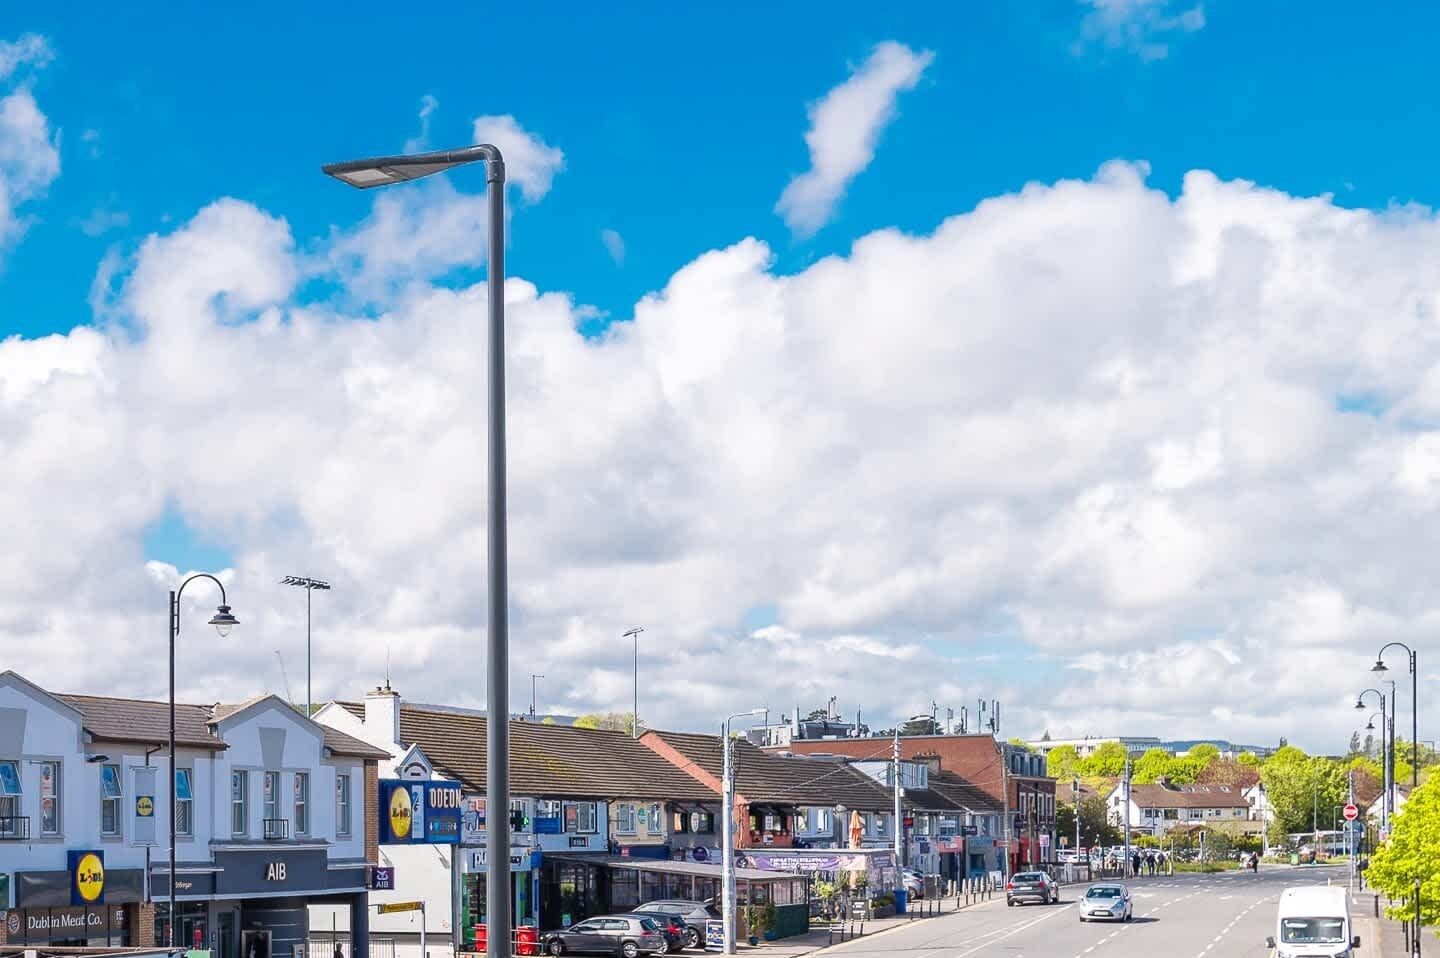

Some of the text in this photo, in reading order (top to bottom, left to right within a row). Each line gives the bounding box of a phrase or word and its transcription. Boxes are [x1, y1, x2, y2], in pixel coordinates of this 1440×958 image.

[431, 788, 461, 808] ODEON
[268, 862, 286, 881] AIB
[28, 915, 60, 929] Dublin
[61, 914, 85, 927] Meat
[87, 912, 103, 926] Co.
